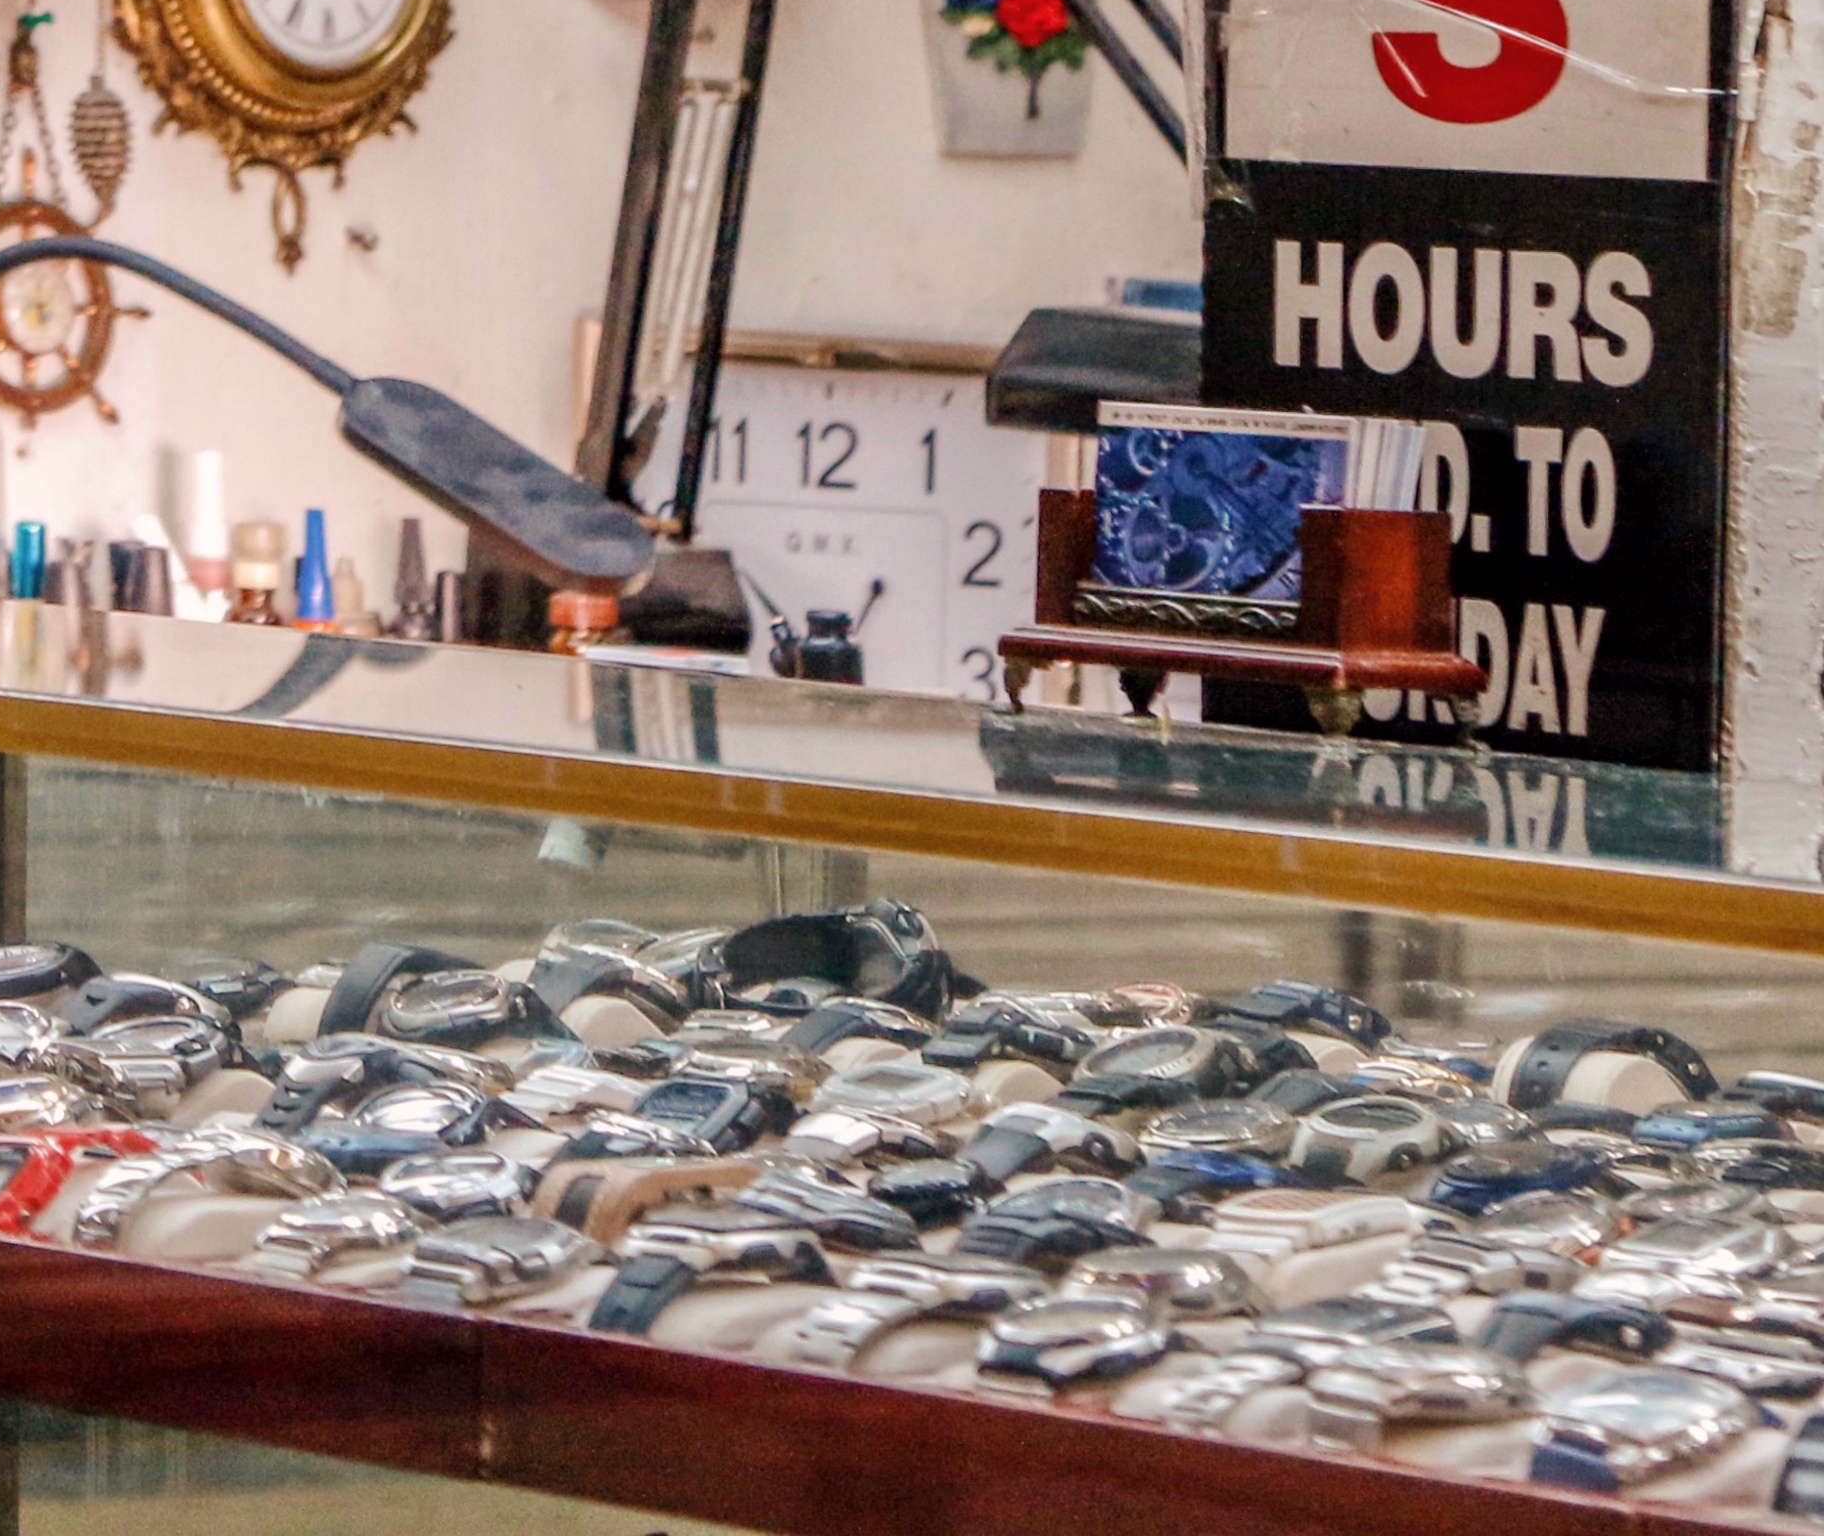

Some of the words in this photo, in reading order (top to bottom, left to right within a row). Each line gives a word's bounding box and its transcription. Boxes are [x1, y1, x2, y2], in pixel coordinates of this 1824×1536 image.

[1274, 240, 1654, 389] HOURS
[708, 416, 747, 483] 11
[797, 420, 858, 490] 12
[922, 427, 938, 495] 1
[1514, 426, 1616, 563] TO
[963, 519, 1002, 588] 2
[962, 647, 997, 701] 3
